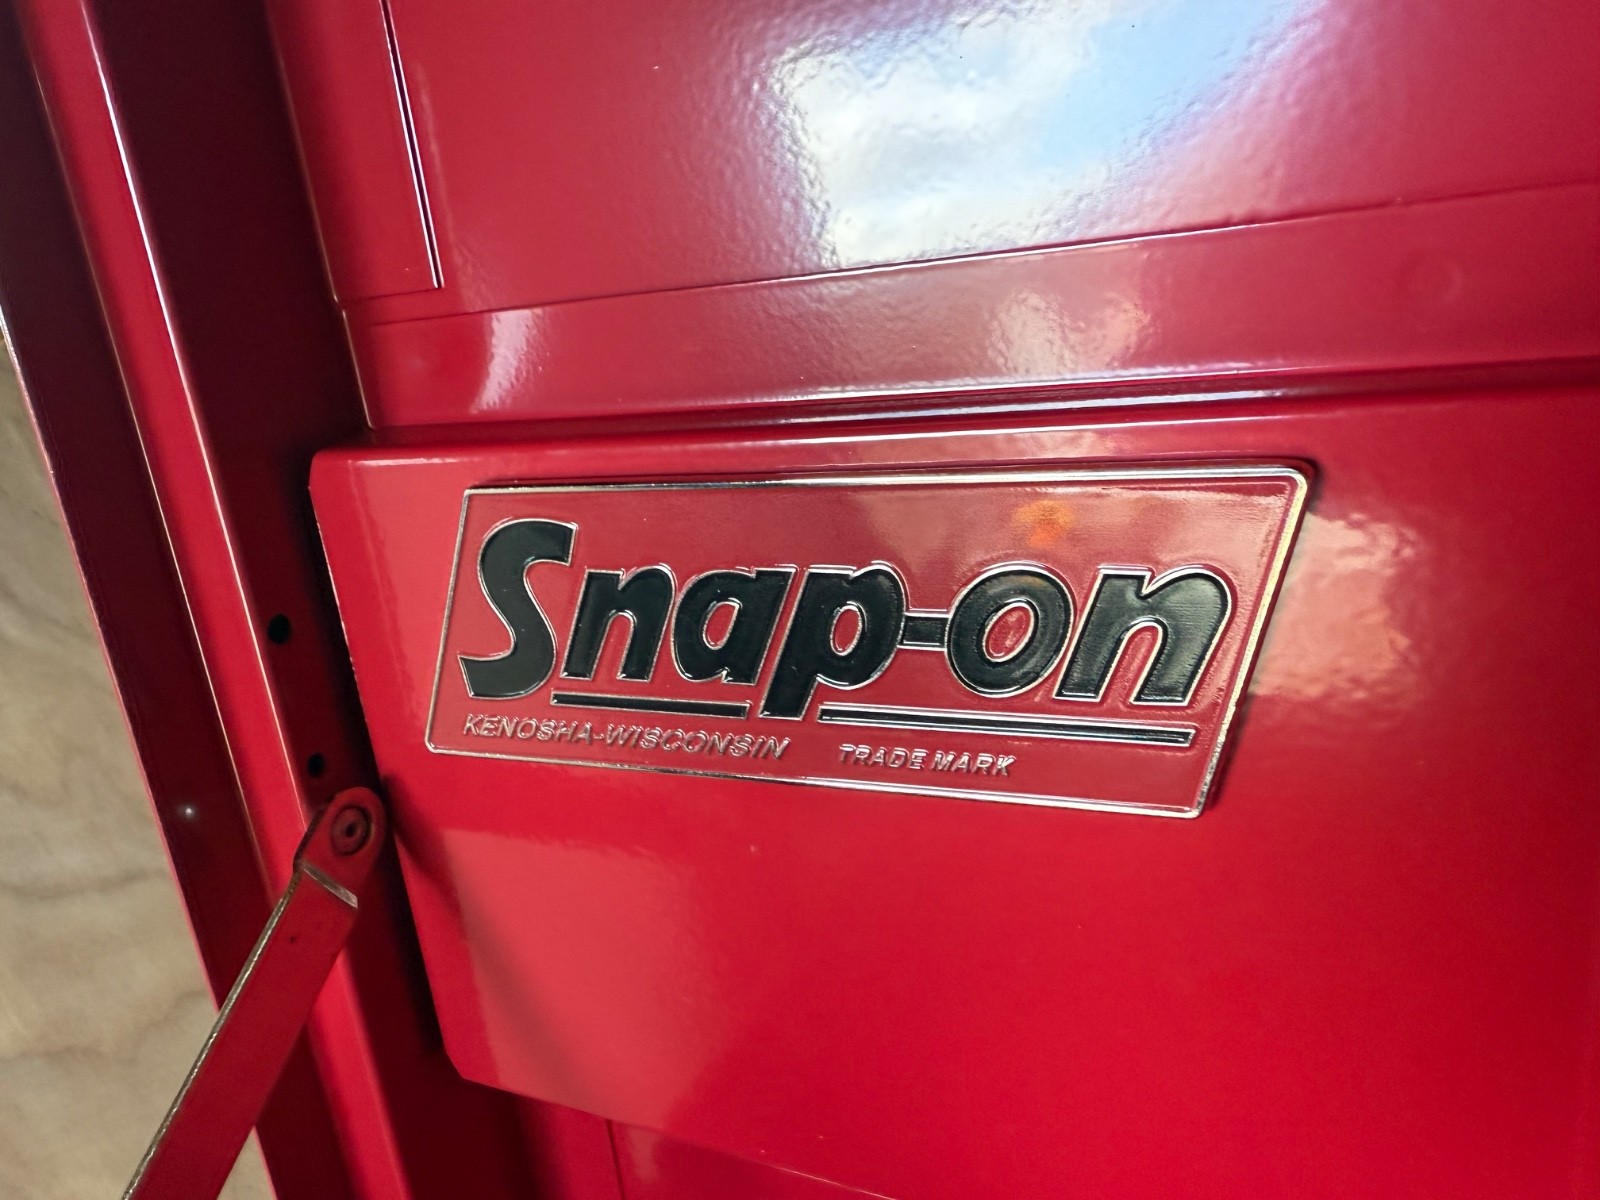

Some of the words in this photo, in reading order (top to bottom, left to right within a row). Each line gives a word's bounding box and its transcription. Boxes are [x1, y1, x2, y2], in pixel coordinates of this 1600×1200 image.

[458, 517, 1233, 720] Snap-on
[463, 713, 791, 760] KENOSHA-WISCONSIN
[838, 743, 928, 772] TRADE
[929, 750, 1017, 777] MARK
